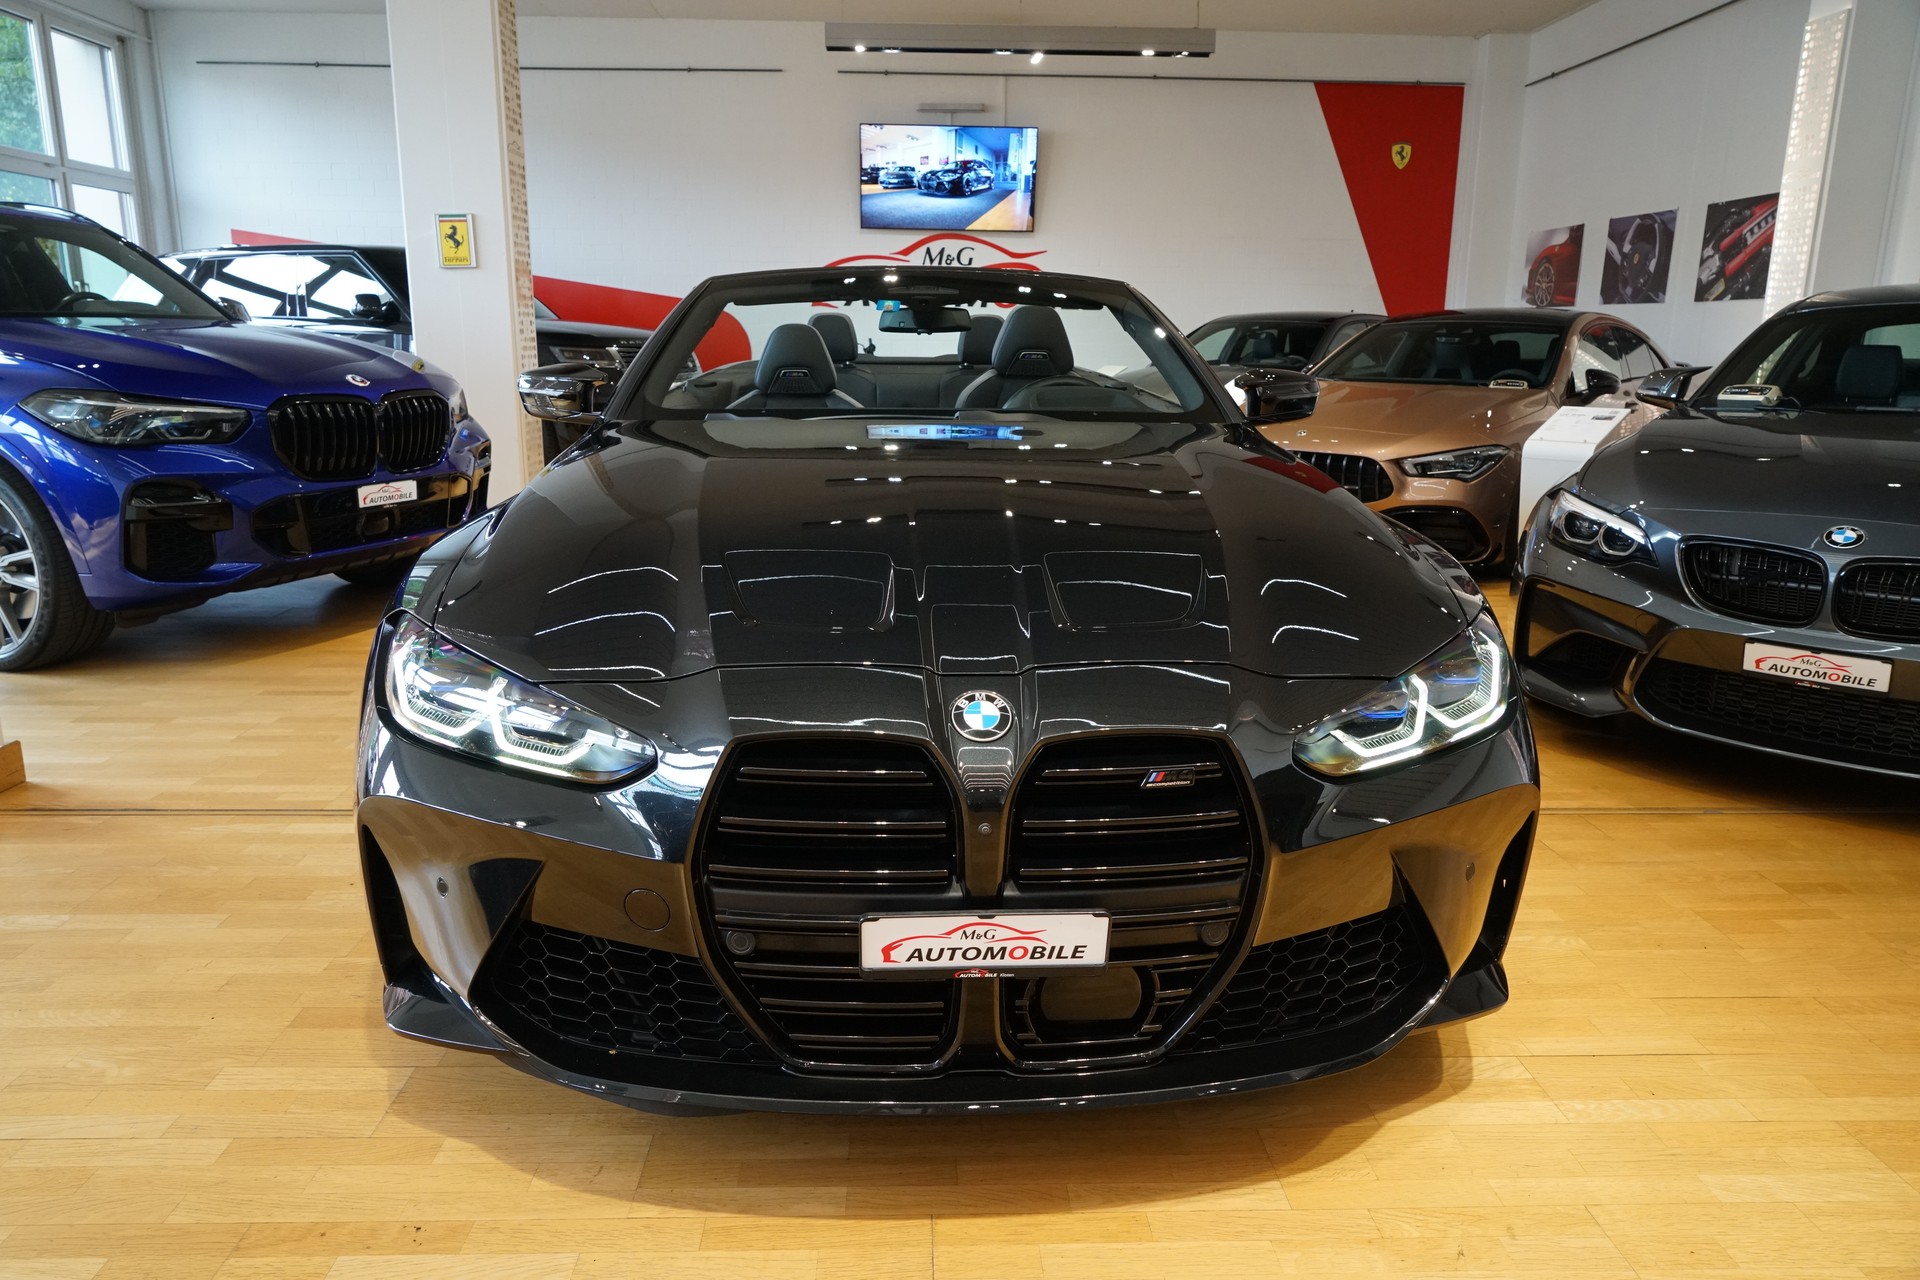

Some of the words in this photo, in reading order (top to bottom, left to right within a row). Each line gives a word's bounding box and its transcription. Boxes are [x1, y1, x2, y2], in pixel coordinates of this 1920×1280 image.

[922, 246, 975, 266] M&G
[369, 492, 413, 504] AUTOMOBILE
[1800, 658, 1822, 667] M&G
[1768, 663, 1878, 688] AUTOMOBILE
[957, 692, 1006, 709] BMW
[960, 929, 997, 940] M&G
[905, 945, 1088, 962] AUTOMOBILE
